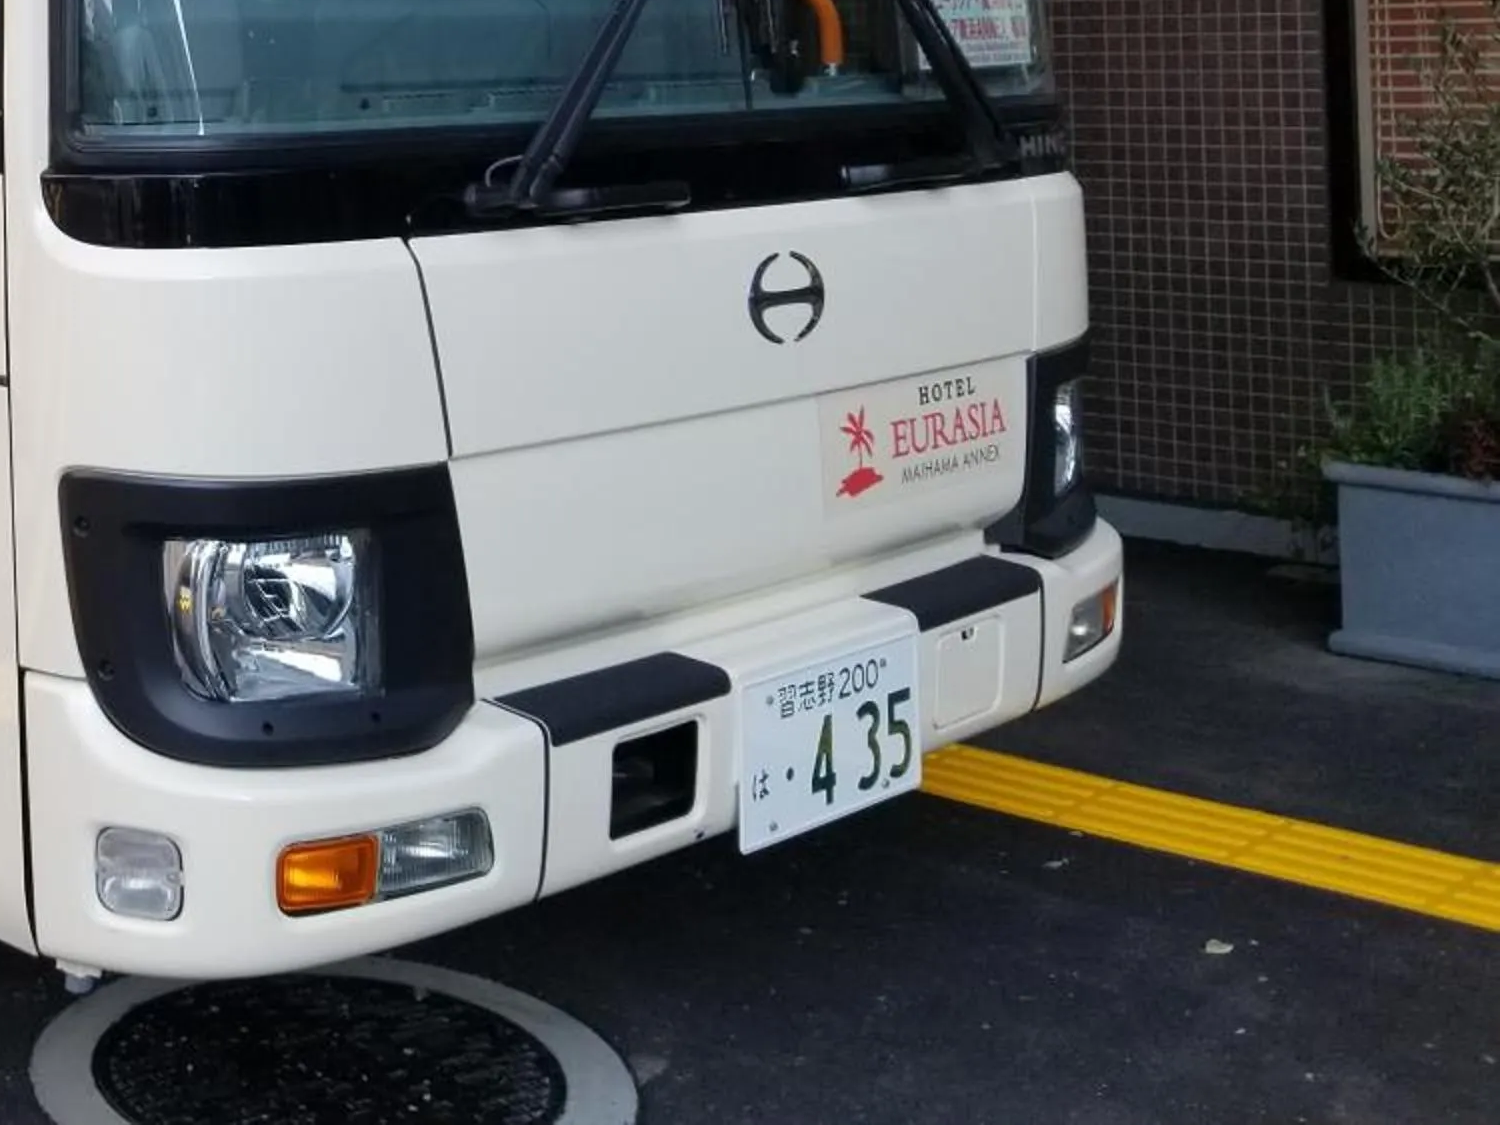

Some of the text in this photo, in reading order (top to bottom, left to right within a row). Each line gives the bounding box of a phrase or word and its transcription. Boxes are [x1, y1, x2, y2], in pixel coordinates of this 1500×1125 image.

[917, 376, 976, 405] HOTEL
[890, 398, 1007, 459] EURASIA
[901, 444, 999, 484] MAIHAMA ANNEX
